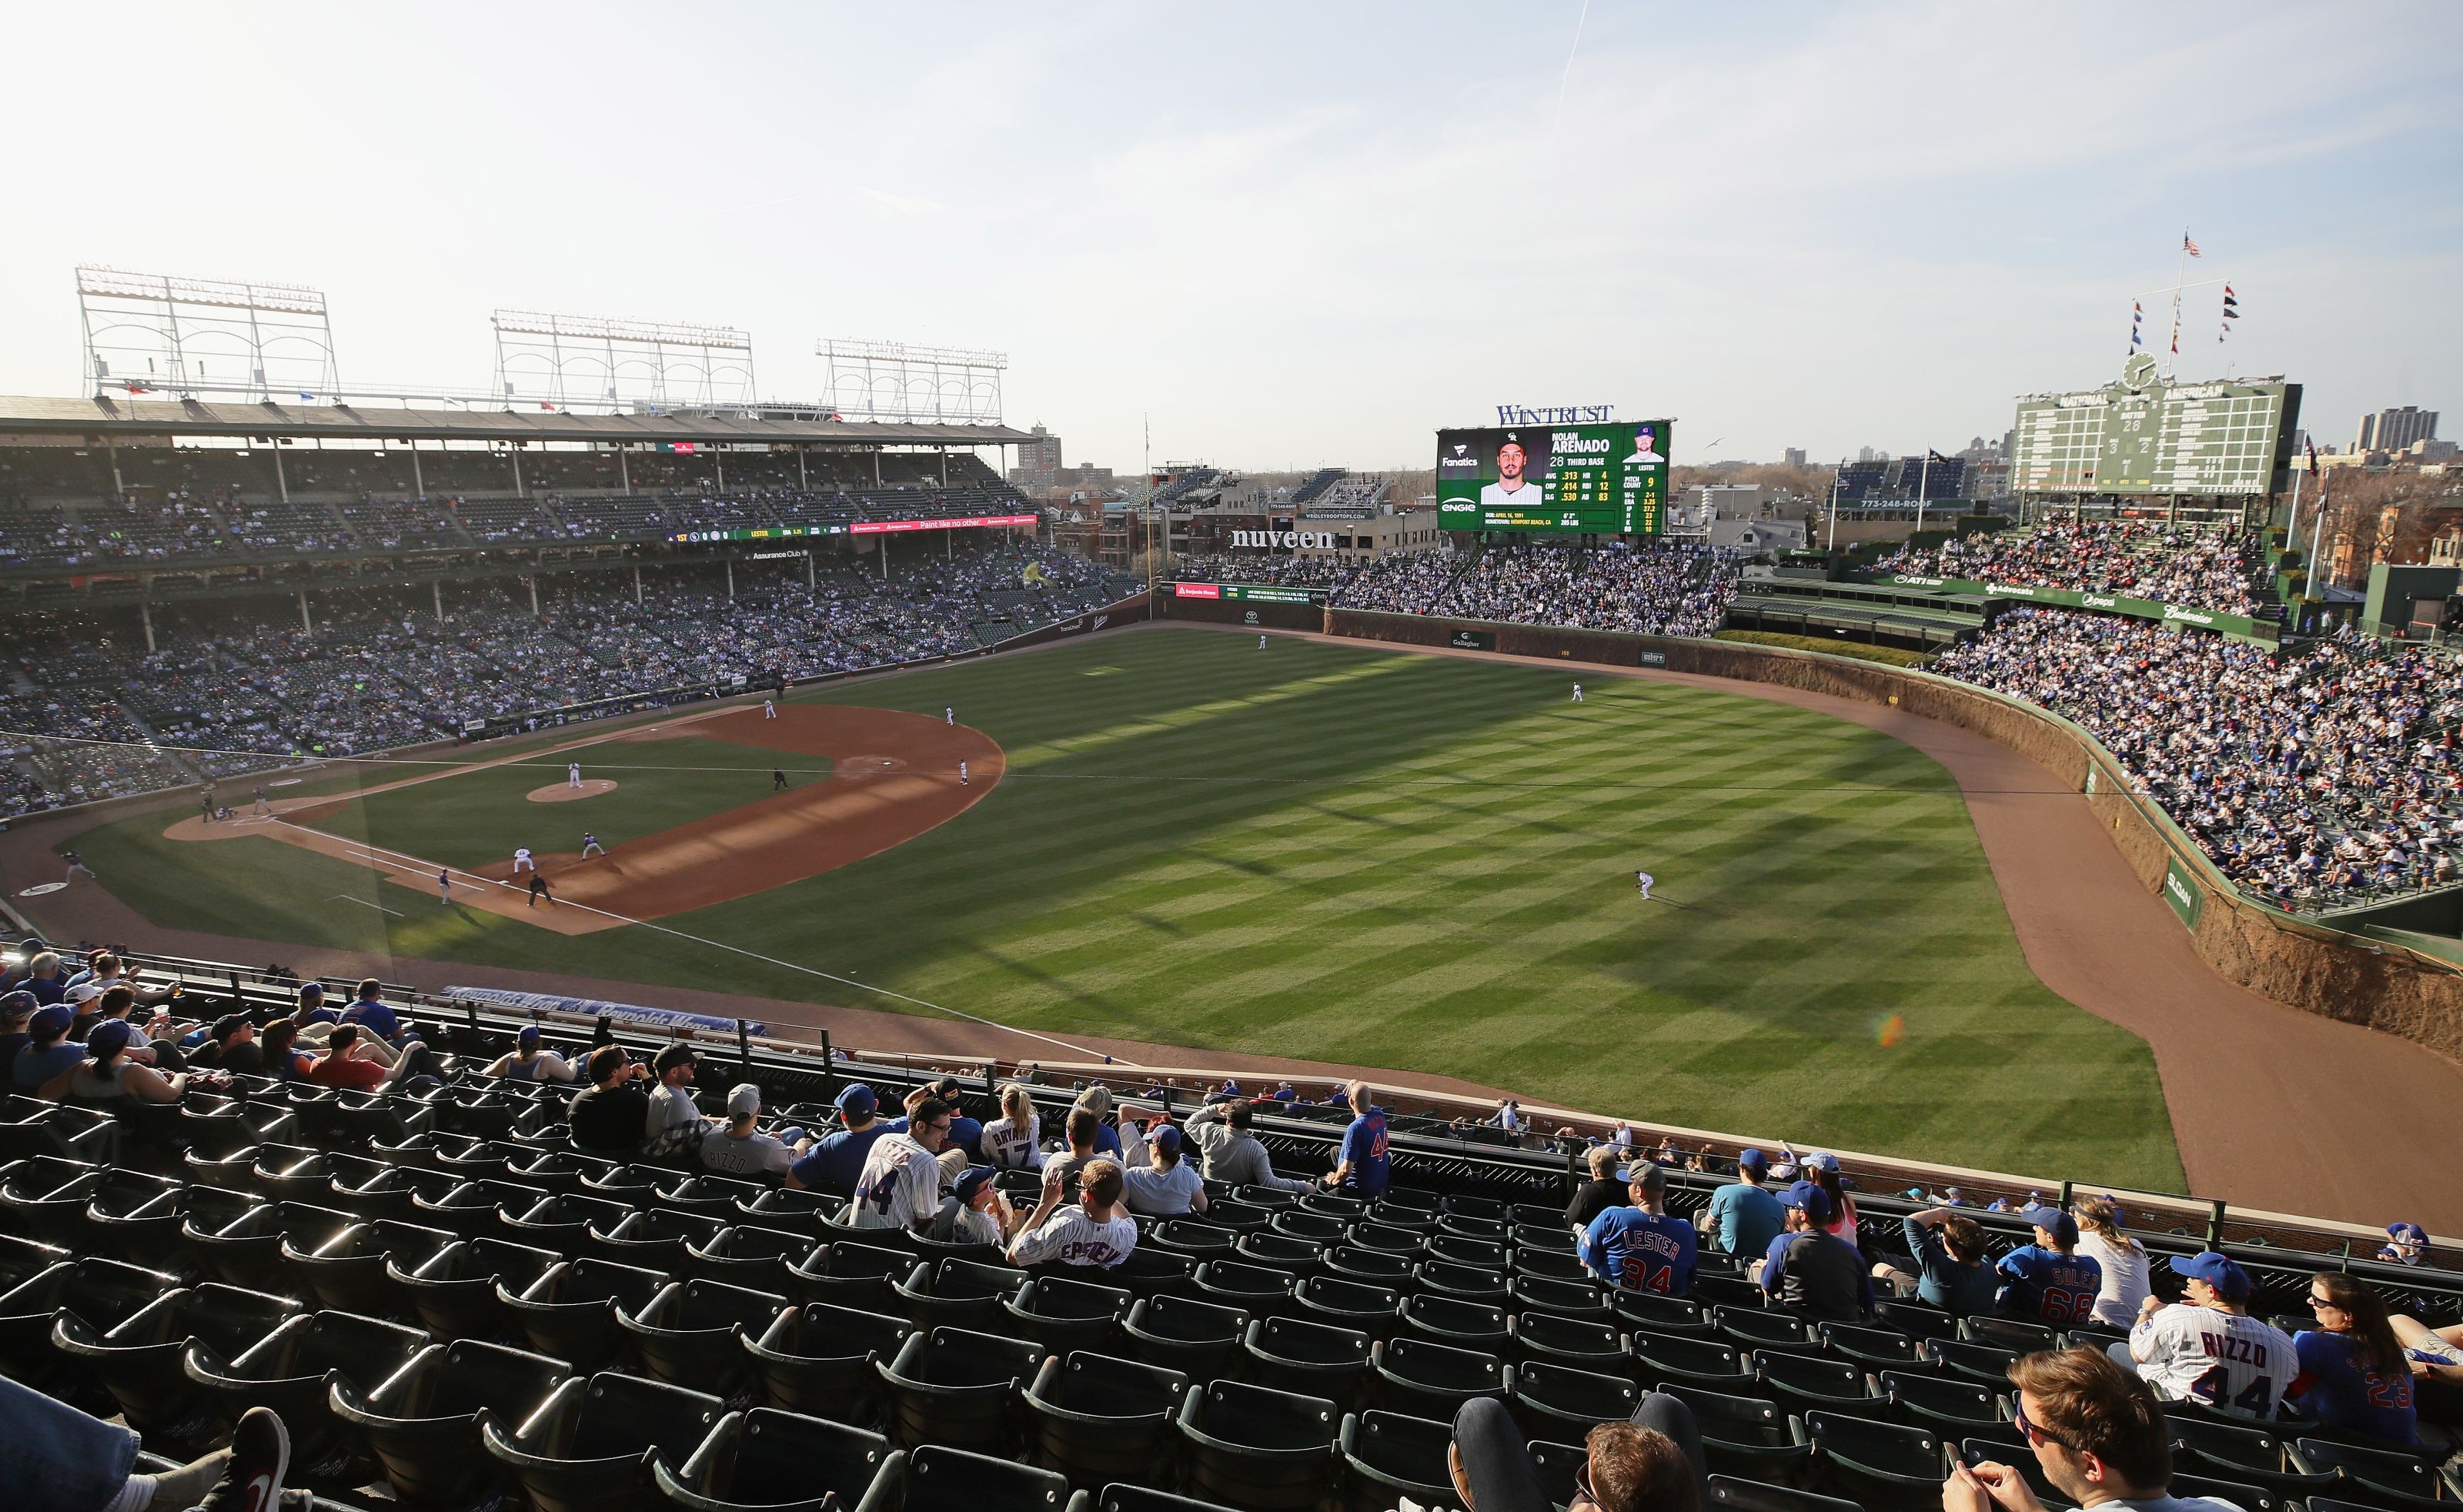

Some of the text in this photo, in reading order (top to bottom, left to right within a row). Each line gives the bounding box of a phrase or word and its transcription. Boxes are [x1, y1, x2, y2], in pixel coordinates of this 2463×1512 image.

[2163, 385, 2224, 400] AMERICAN
[2060, 394, 2109, 408] NATIONAL
[1496, 405, 1614, 425] WINTRUST
[2120, 411, 2146, 420] BATTER
[2123, 420, 2141, 432] 28
[1552, 432, 1578, 441] NOLAN
[1552, 439, 1610, 453] ARENADO
[2109, 443, 2117, 454] 3
[2140, 442, 2149, 454] 2
[1442, 457, 1478, 466] Fanatics
[1550, 456, 1564, 466] 28
[1562, 472, 1578, 480] .313
[1649, 477, 1654, 487] 9
[1562, 482, 1578, 491] .414
[1599, 482, 1609, 490] 12
[1599, 492, 1608, 501] 83
[1232, 530, 1334, 549] nuveen
[1311, 592, 1328, 600] xfinity
[1997, 585, 2034, 596] Advocate
[2092, 597, 2115, 606] pepsi
[2164, 605, 2214, 624] Budweiser
[1453, 639, 1479, 648] Gallagher
[2167, 873, 2191, 908] SLOAN
[596, 1003, 668, 1025] Reynolds
[669, 1014, 710, 1031] Wrap
[998, 1141, 1032, 1167] 17
[710, 1152, 745, 1172] RIZZO
[856, 1164, 899, 1216] 44
[1624, 1231, 1679, 1261] LESTER
[1619, 1256, 1672, 1294] 34
[2052, 1268, 2098, 1290] SOLER
[2040, 1287, 2094, 1323] 68
[2201, 1331, 2266, 1368] RIZZO
[2191, 1364, 2272, 1420] 44
[2365, 1373, 2411, 1409] 23
